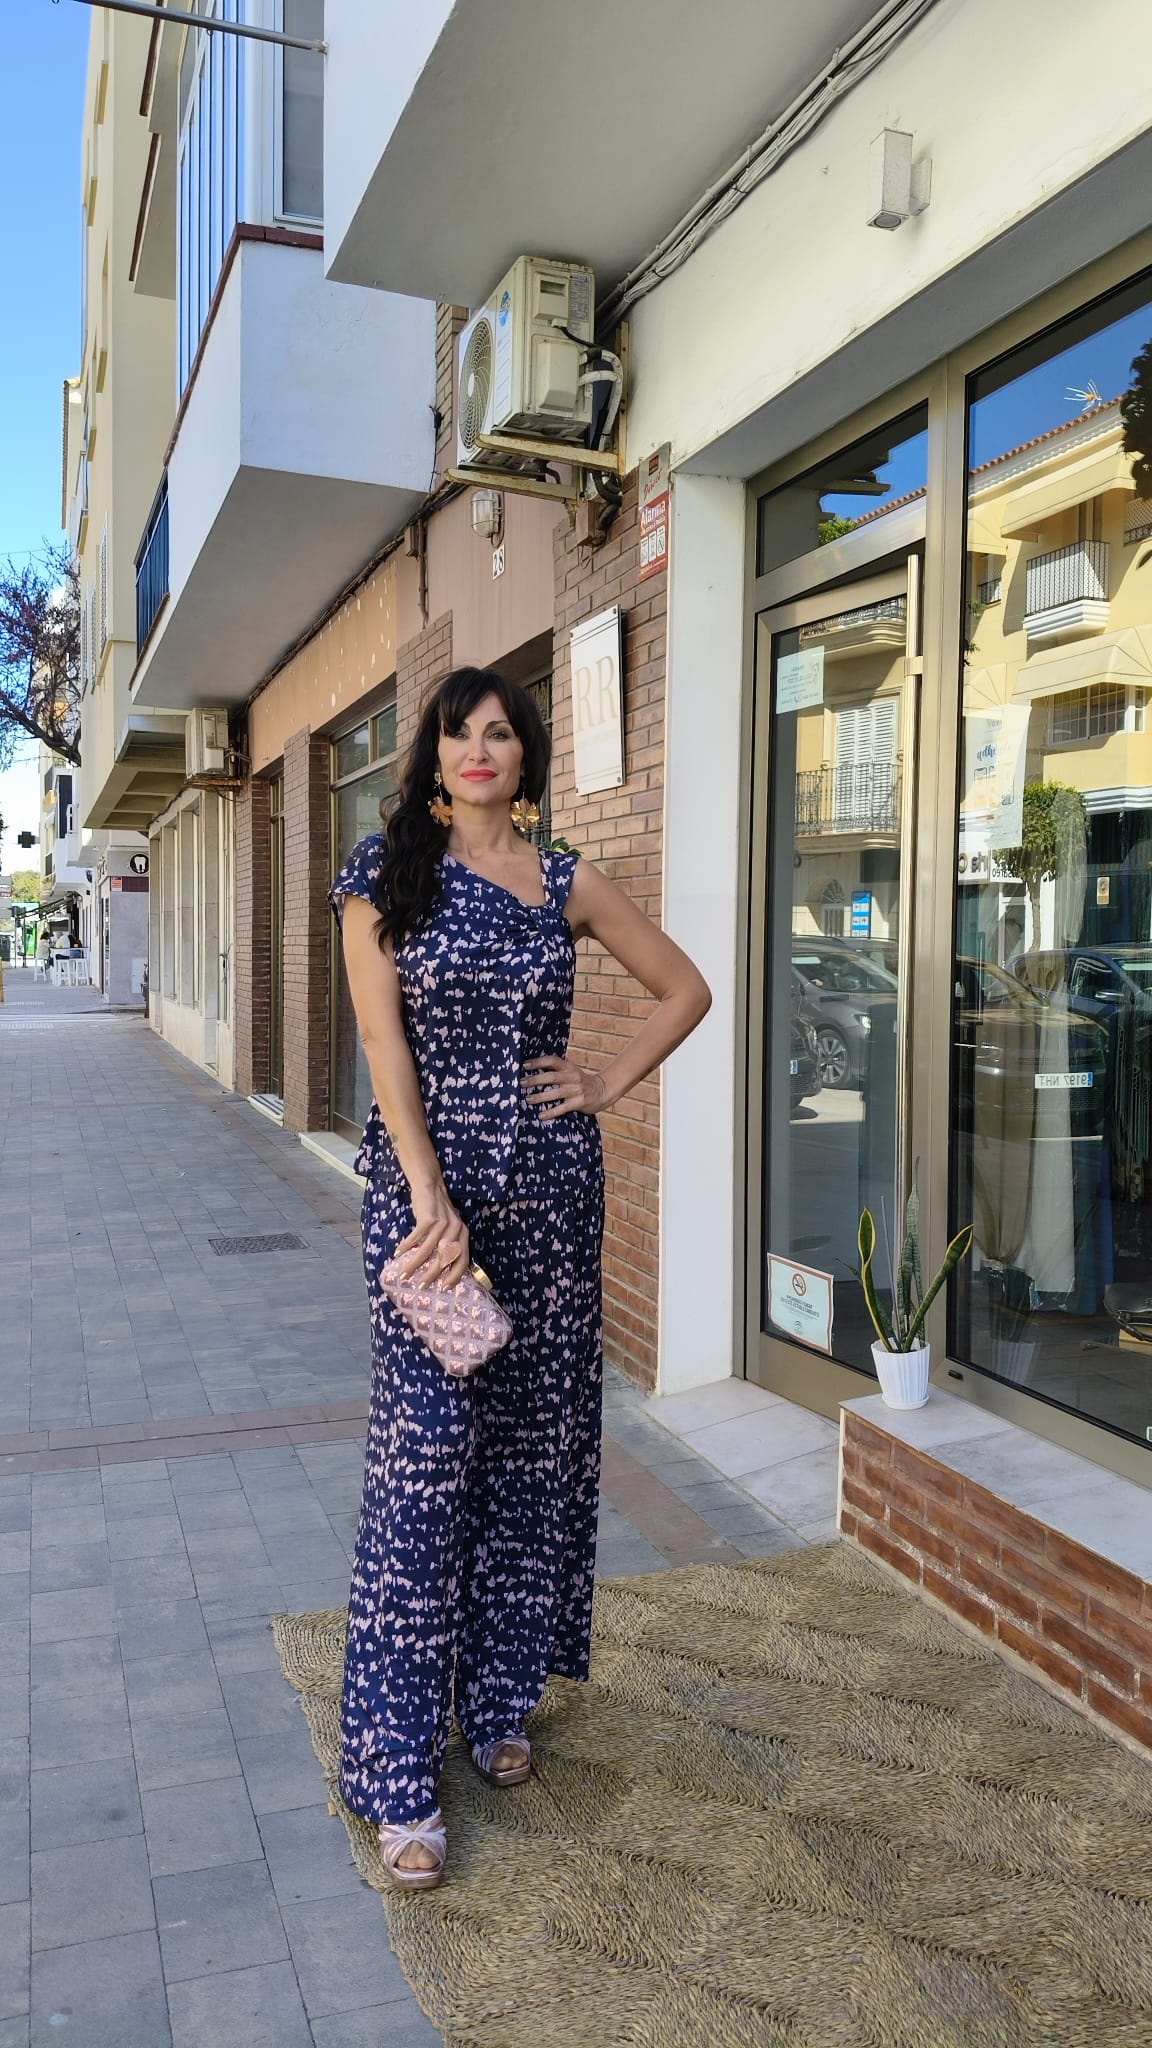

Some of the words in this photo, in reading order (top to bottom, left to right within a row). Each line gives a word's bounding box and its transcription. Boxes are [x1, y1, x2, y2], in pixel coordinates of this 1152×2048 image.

[641, 500, 666, 526] Alarma
[493, 548, 504, 577] 28
[574, 655, 619, 732] RR
